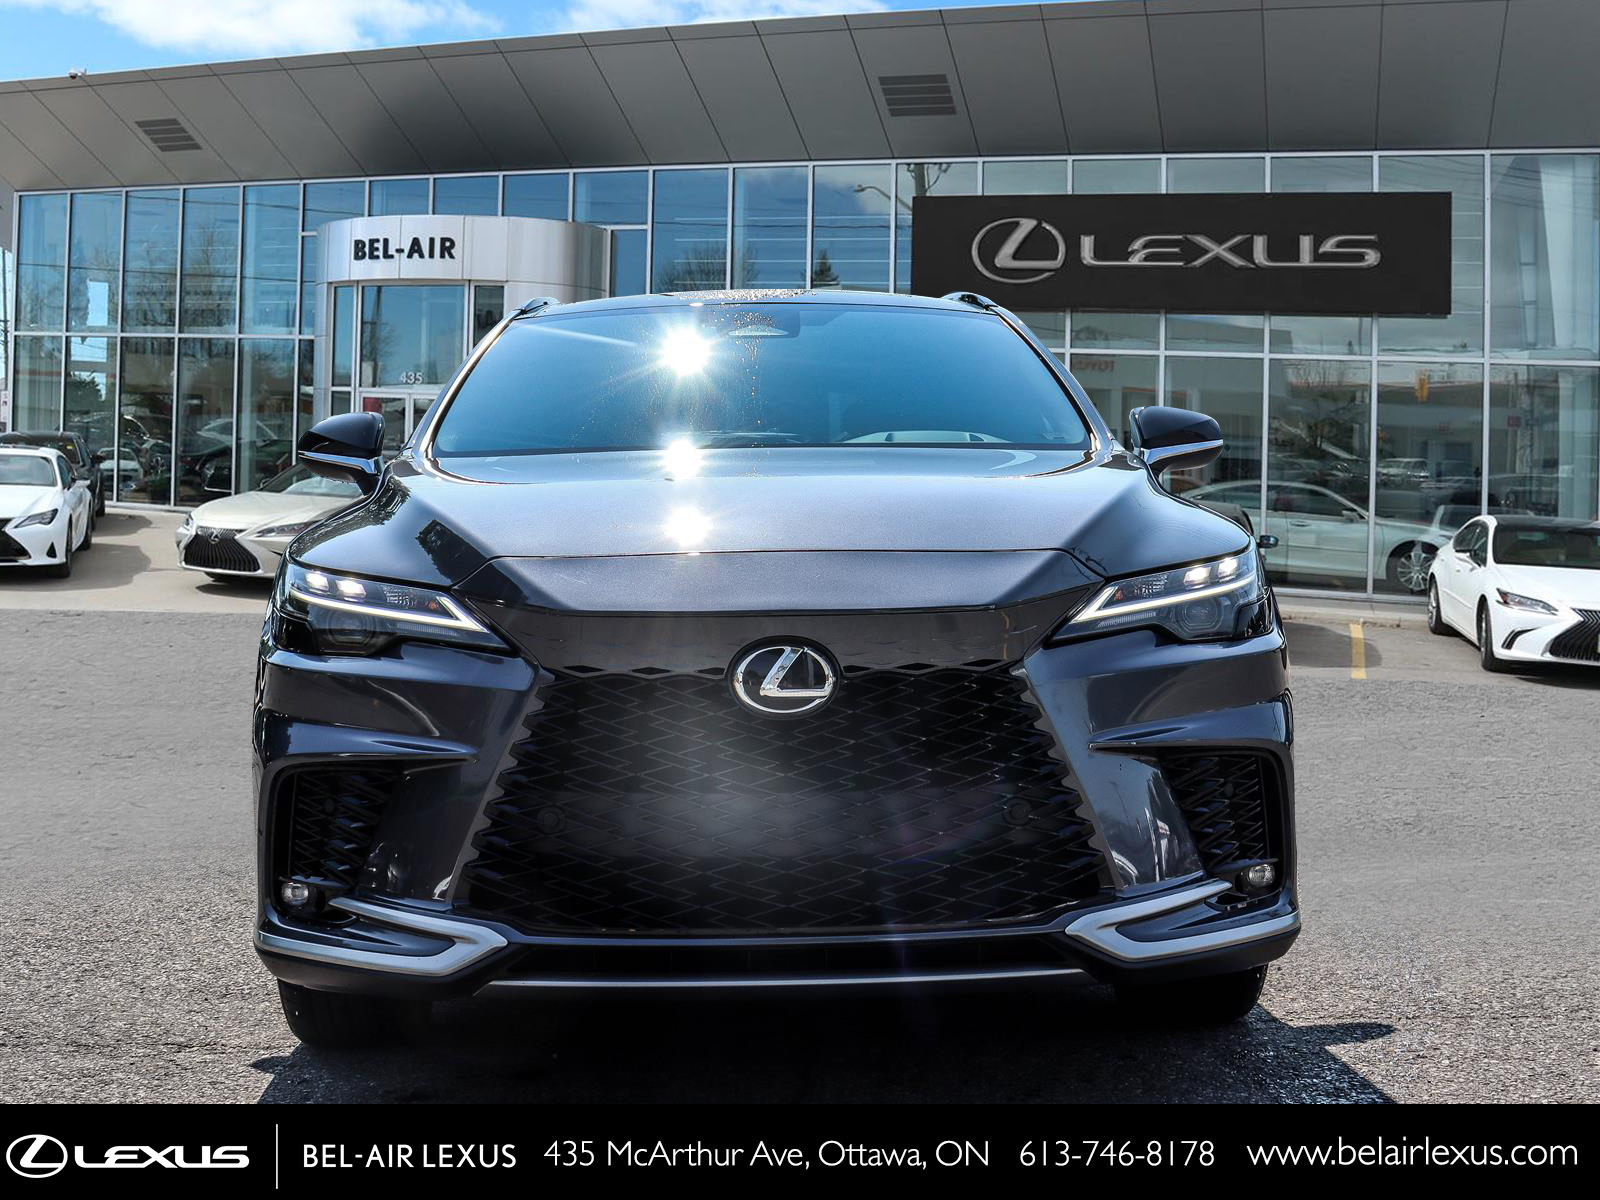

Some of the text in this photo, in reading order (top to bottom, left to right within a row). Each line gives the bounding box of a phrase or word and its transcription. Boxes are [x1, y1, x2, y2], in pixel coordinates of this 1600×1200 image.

[353, 236, 456, 261] BEL-AIR
[1080, 233, 1382, 269] LEXUS
[400, 371, 424, 385] 435
